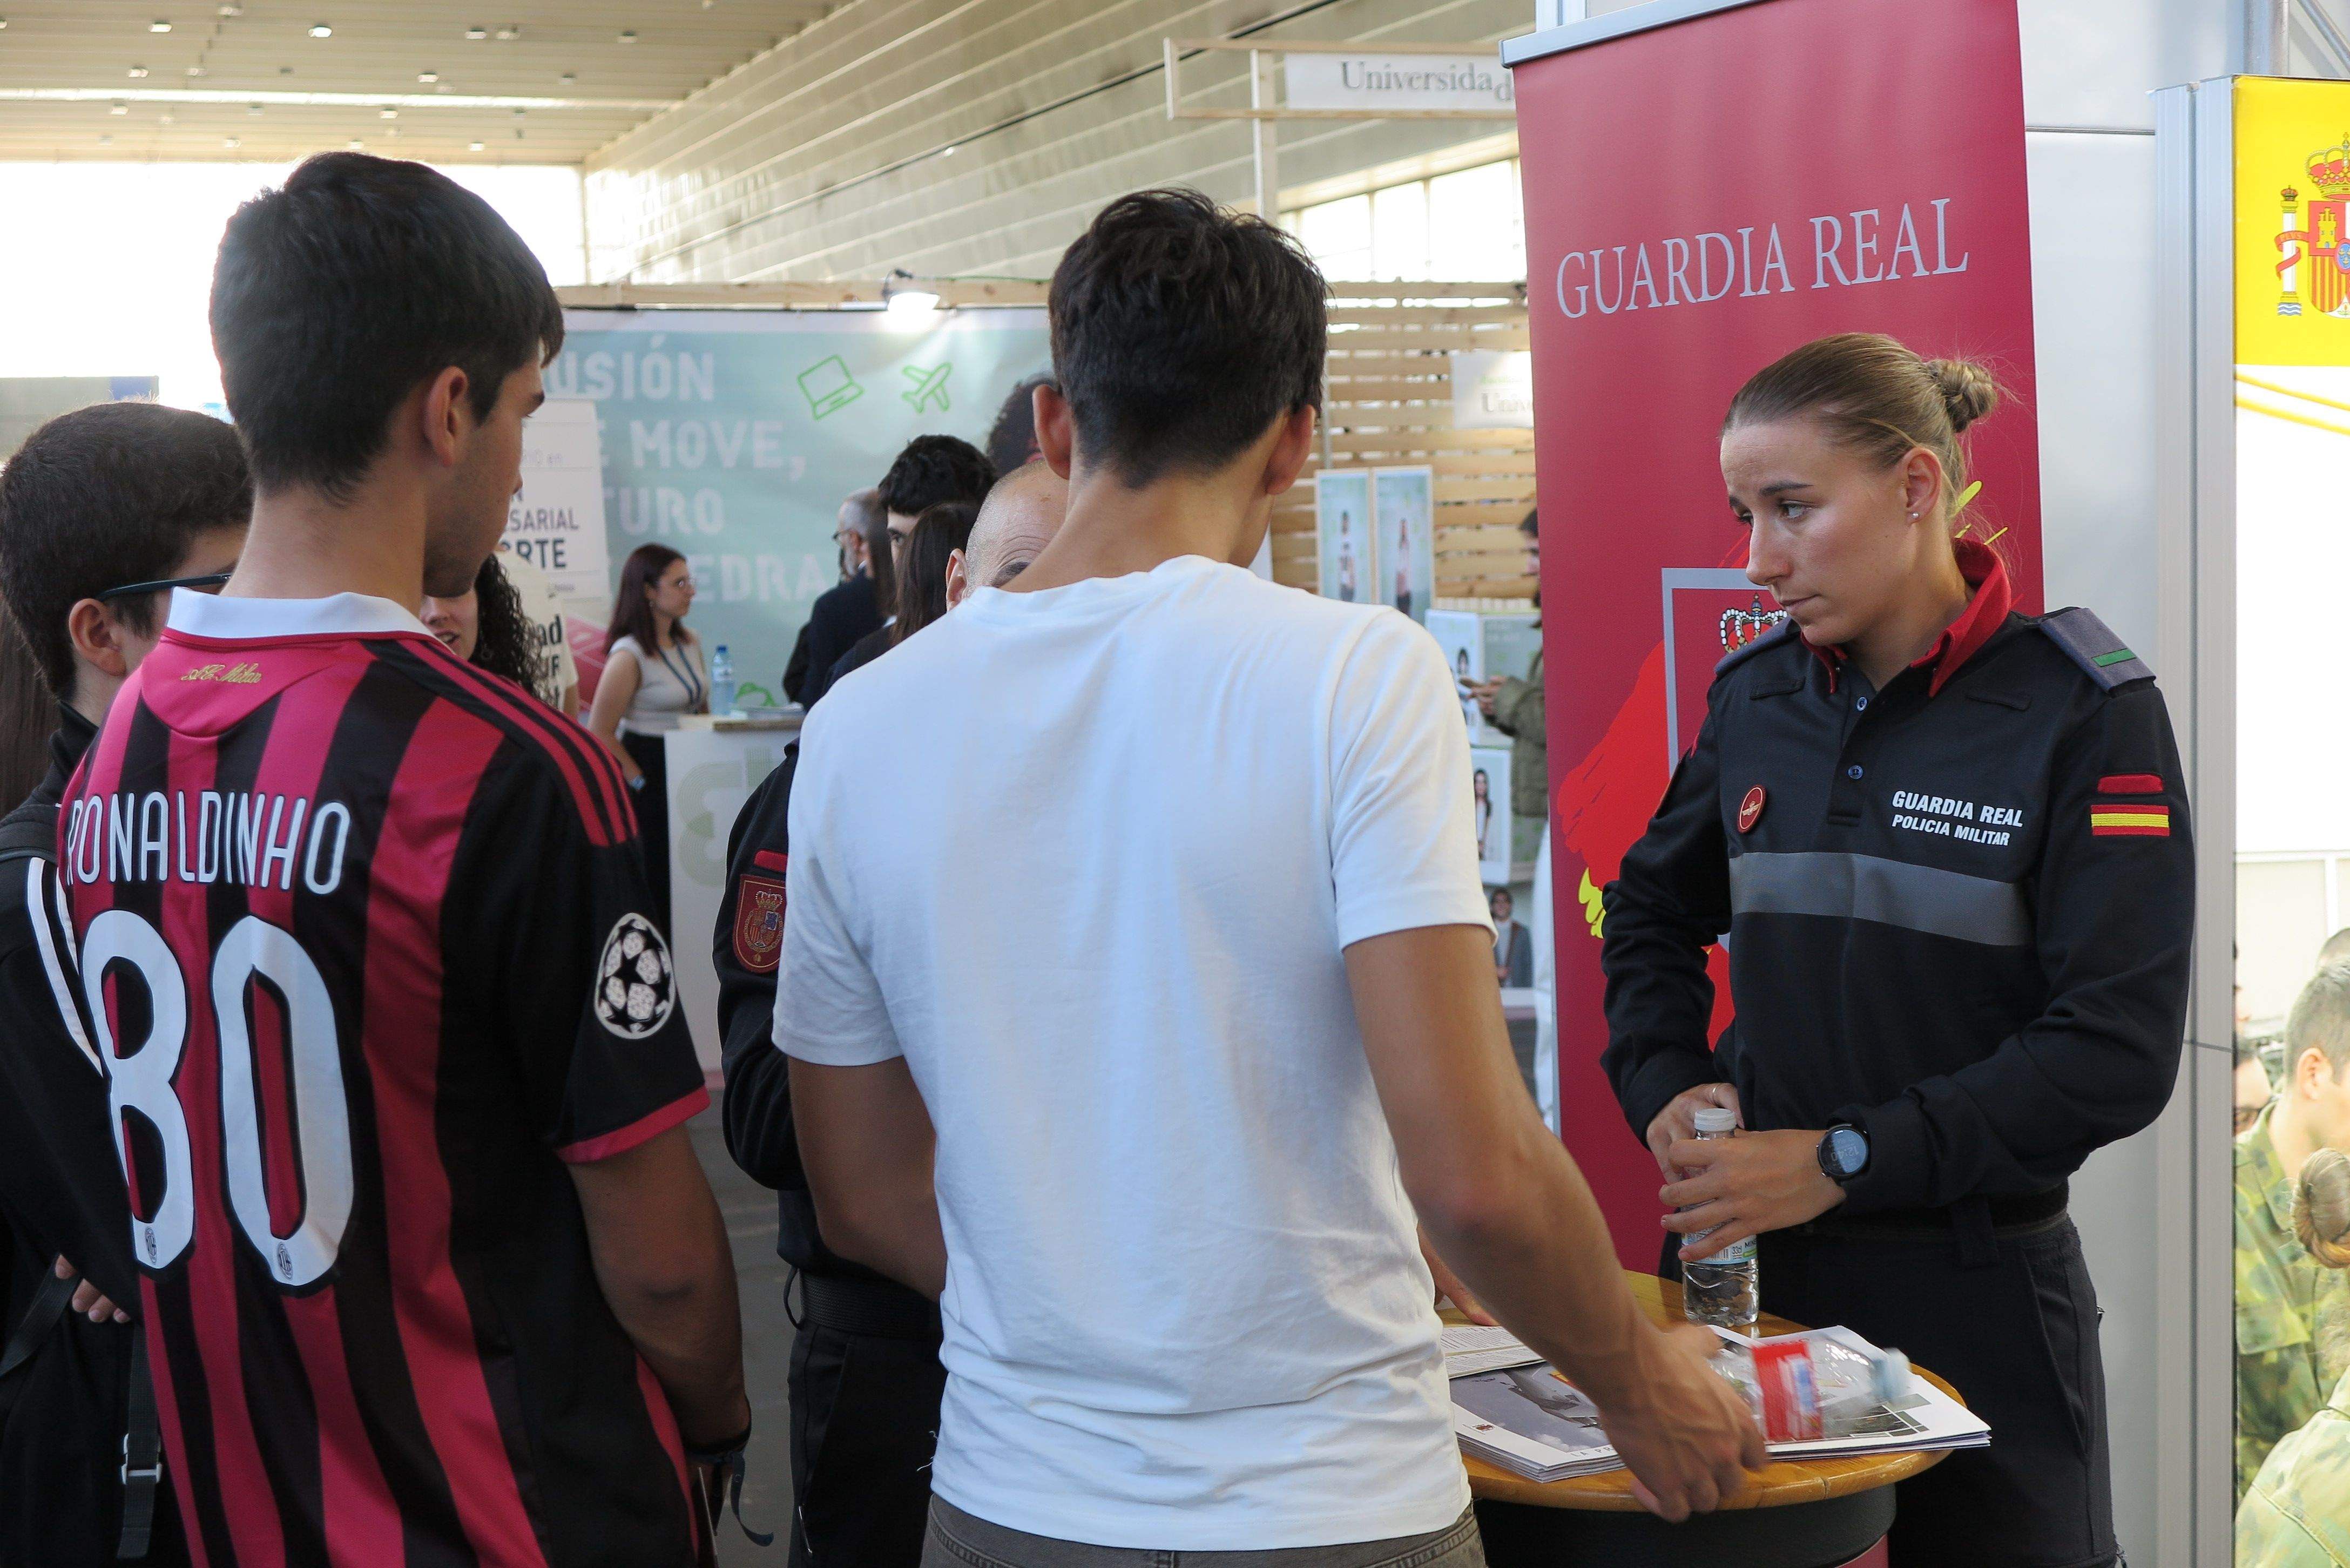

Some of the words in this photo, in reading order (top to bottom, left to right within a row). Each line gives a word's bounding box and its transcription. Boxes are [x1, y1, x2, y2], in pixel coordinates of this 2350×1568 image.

[1556, 222, 1795, 319] GUARDIA
[1809, 198, 1969, 290] REAL
[630, 420, 807, 481] MOVE,
[66, 790, 350, 895] RONALDINHO
[1891, 814, 1950, 836] POLICIA
[1953, 824, 2011, 847] MILITAR
[1892, 790, 1974, 820] GUARDIA
[1979, 805, 2024, 828] REAL
[82, 909, 354, 1287] 80
